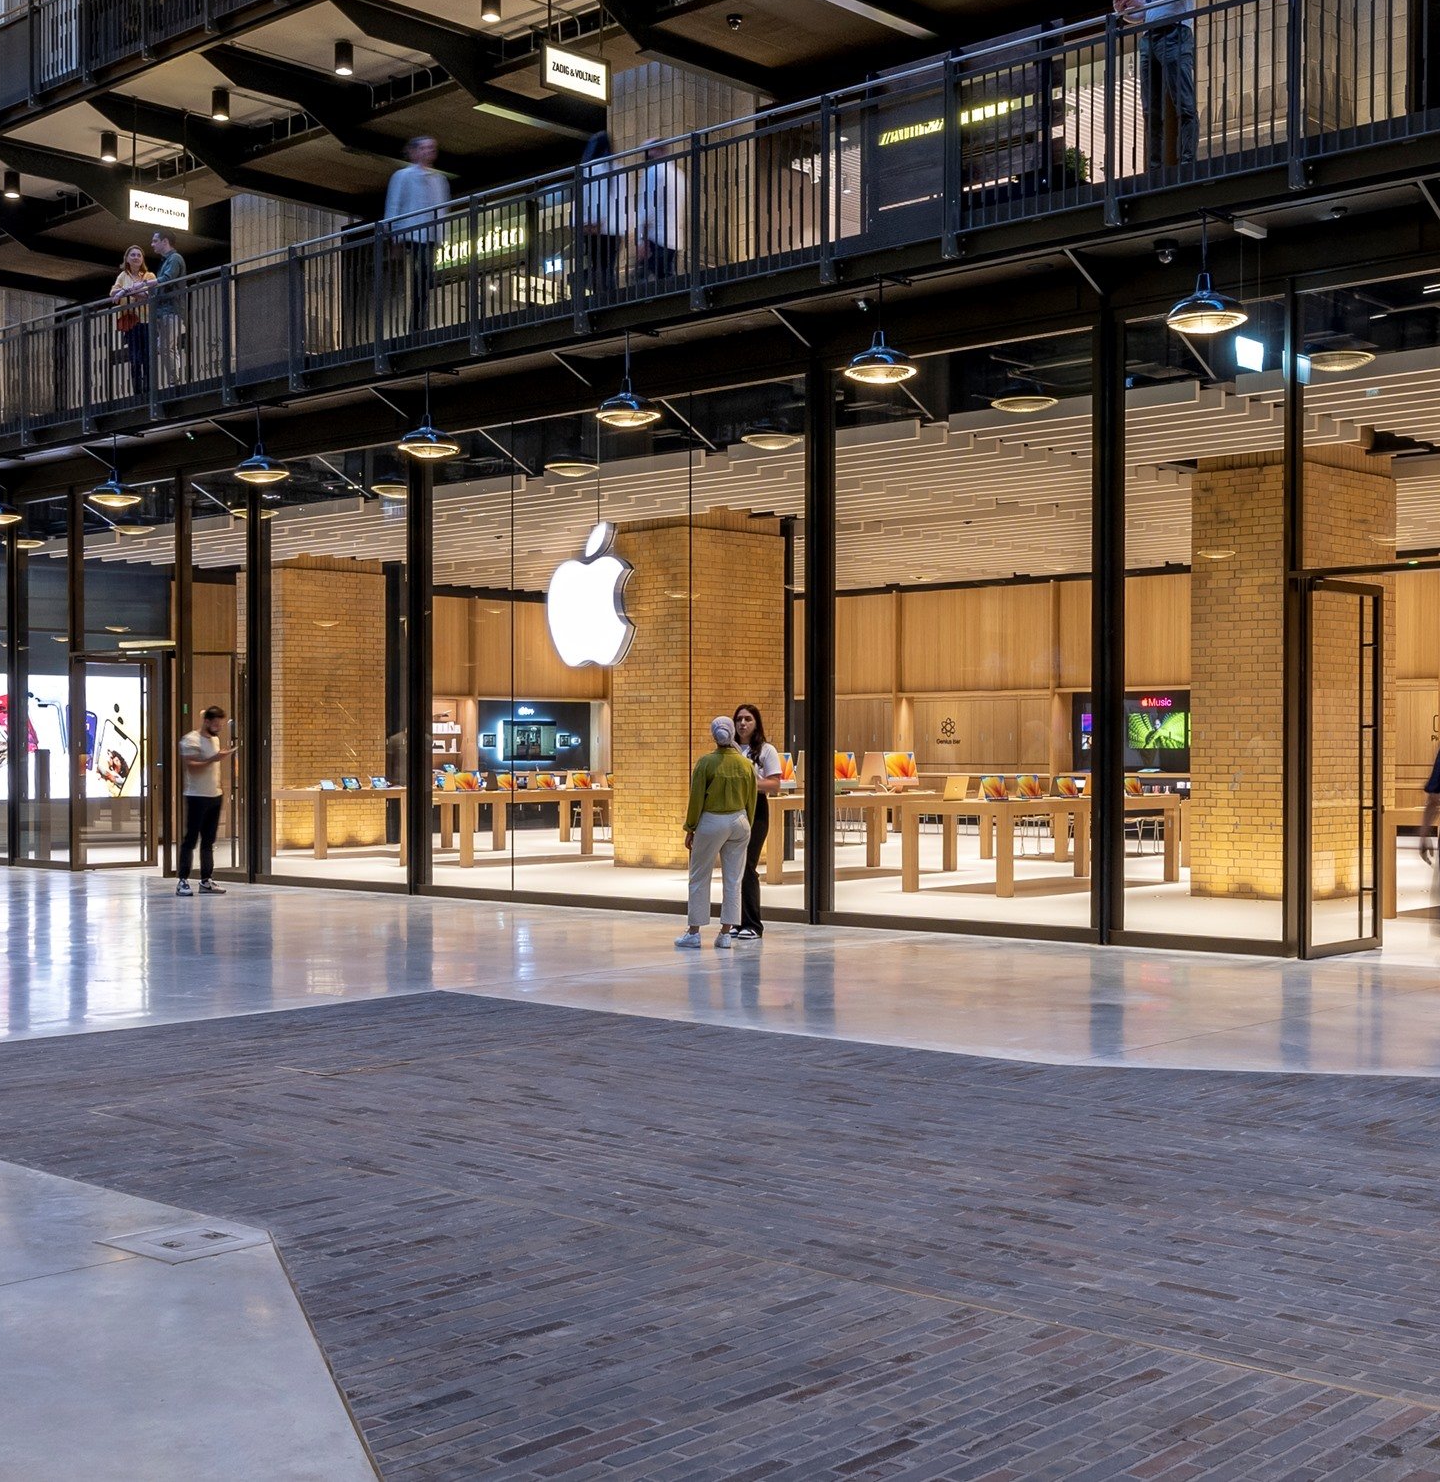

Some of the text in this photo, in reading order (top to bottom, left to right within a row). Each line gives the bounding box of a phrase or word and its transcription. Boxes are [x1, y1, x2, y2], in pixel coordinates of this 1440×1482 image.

[552, 61, 601, 86] ZADIG & VOLTAIRE
[134, 201, 186, 218] Reformation
[1148, 698, 1172, 707] Music
